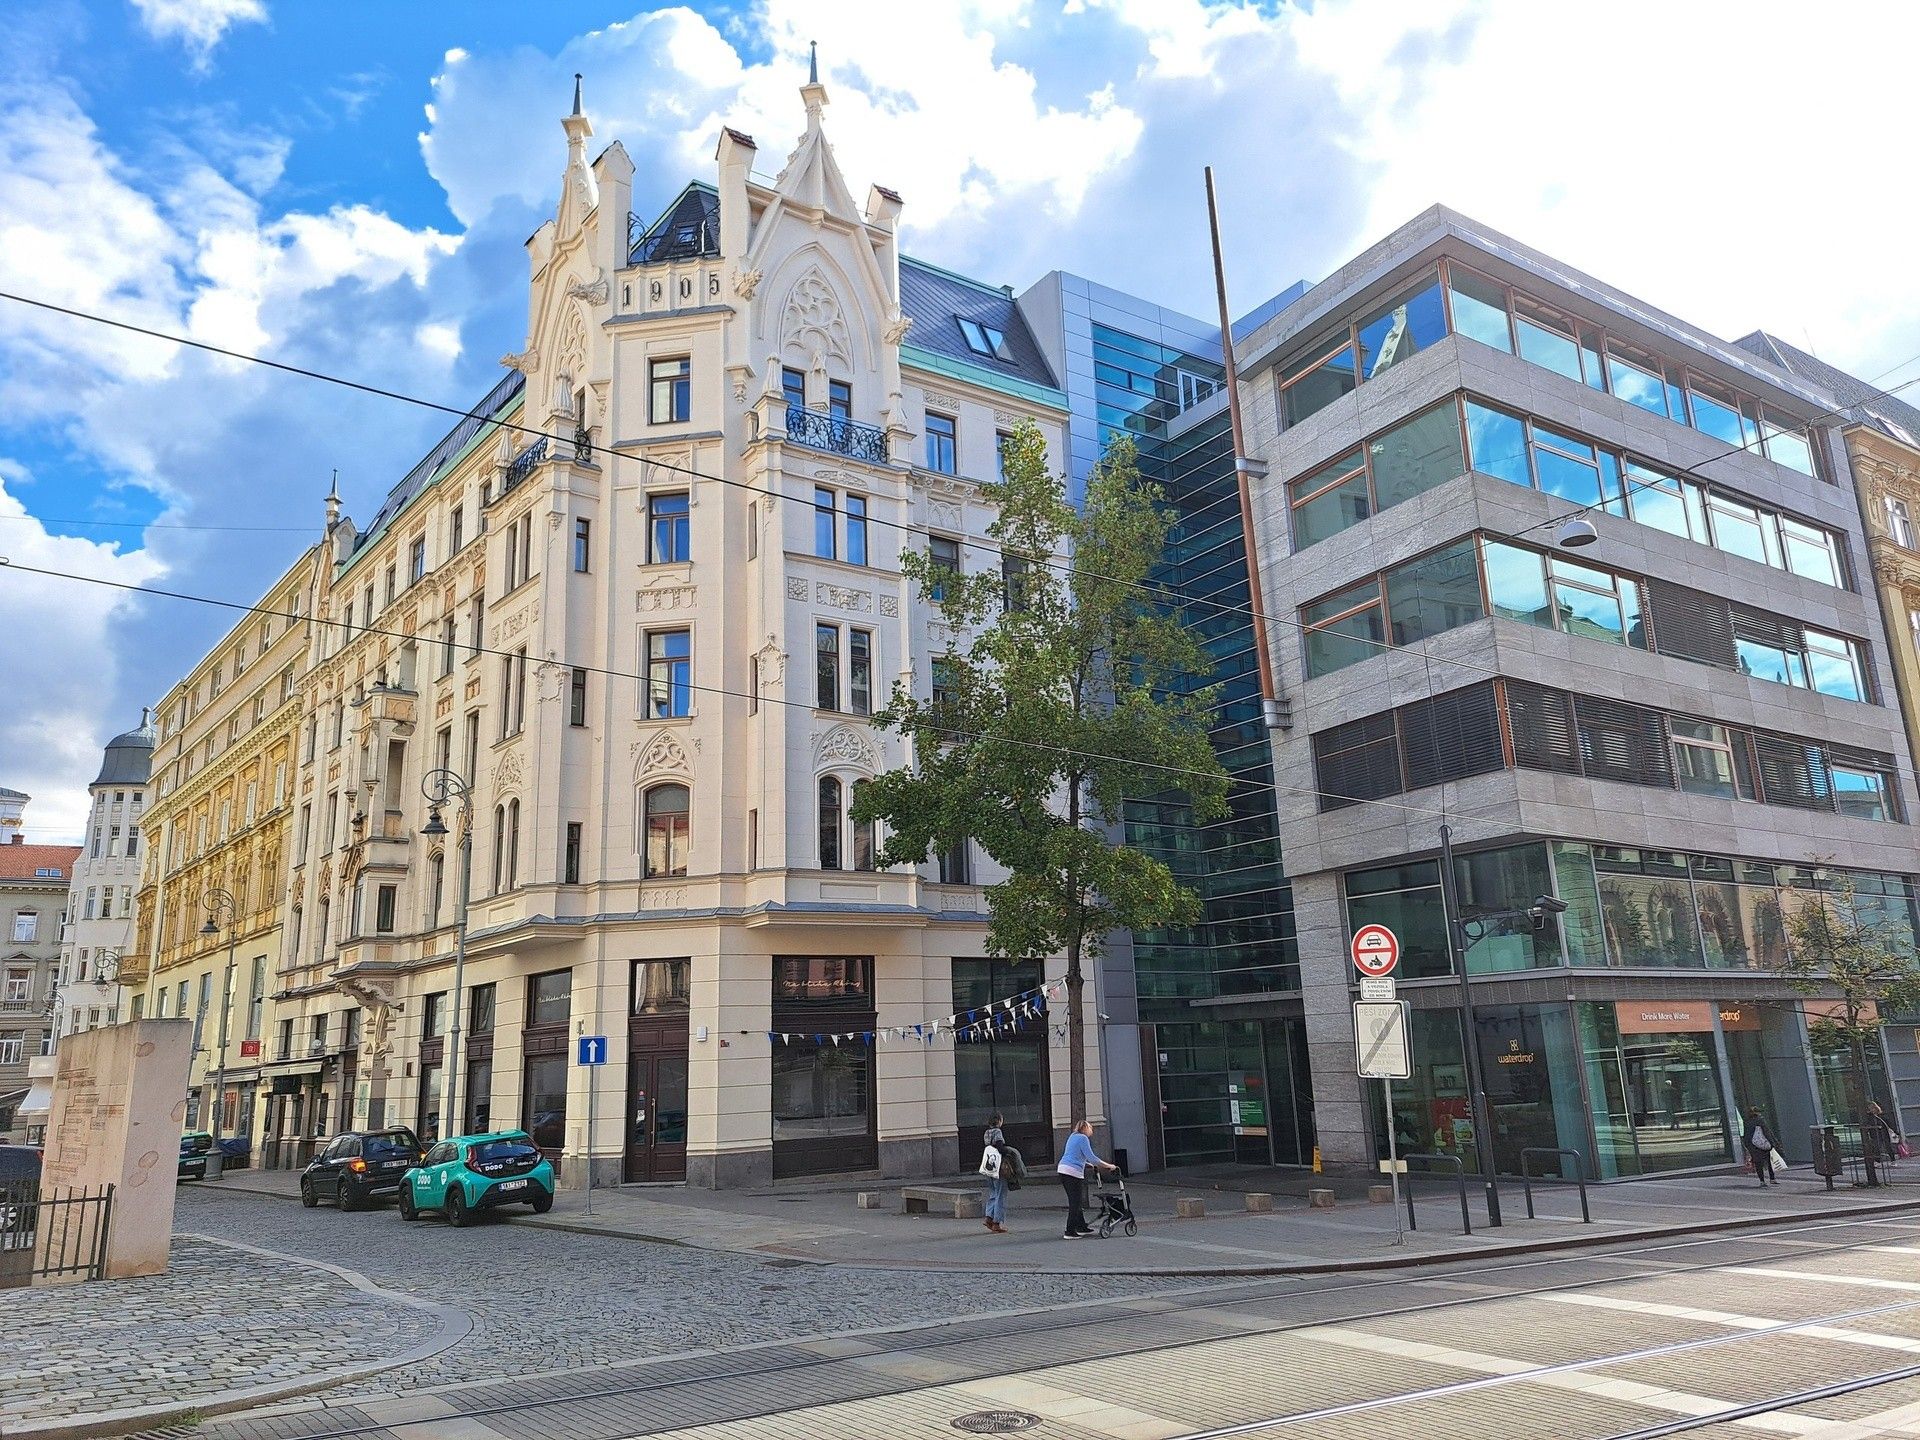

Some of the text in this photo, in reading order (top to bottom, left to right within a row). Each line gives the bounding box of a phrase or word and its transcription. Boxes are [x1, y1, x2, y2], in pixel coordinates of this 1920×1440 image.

[622, 273, 720, 307] 1905
[1641, 1012, 1690, 1020] Drink More Water
[485, 1163, 504, 1171] DODO
